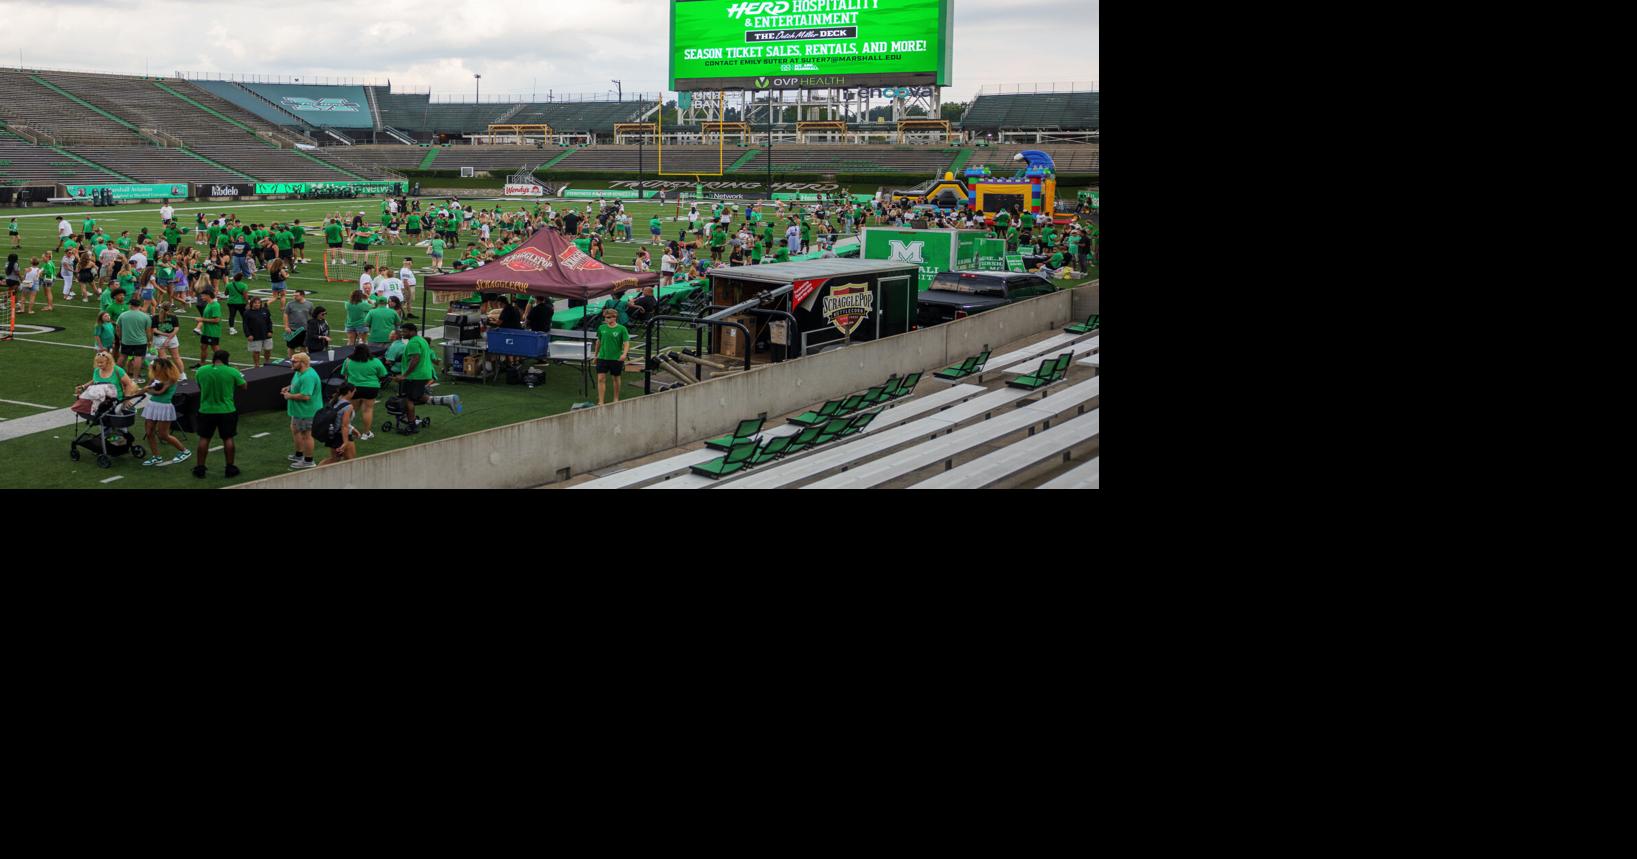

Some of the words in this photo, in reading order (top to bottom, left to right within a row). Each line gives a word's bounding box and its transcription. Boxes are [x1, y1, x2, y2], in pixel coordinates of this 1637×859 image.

[727, 1, 790, 19] HERD
[792, 0, 878, 12] HOSPITALITY
[744, 18, 752, 27] &
[754, 12, 858, 28] ENTERTAINMENT
[820, 29, 847, 38] DECK
[684, 48, 722, 60] SEASON
[726, 46, 763, 58] TICKET
[862, 41, 887, 53] AND
[891, 40, 927, 52] MORE!
[774, 78, 798, 86] OVP
[800, 76, 845, 85] HEALTH
[211, 185, 238, 196] Modelo
[889, 240, 924, 263] M
